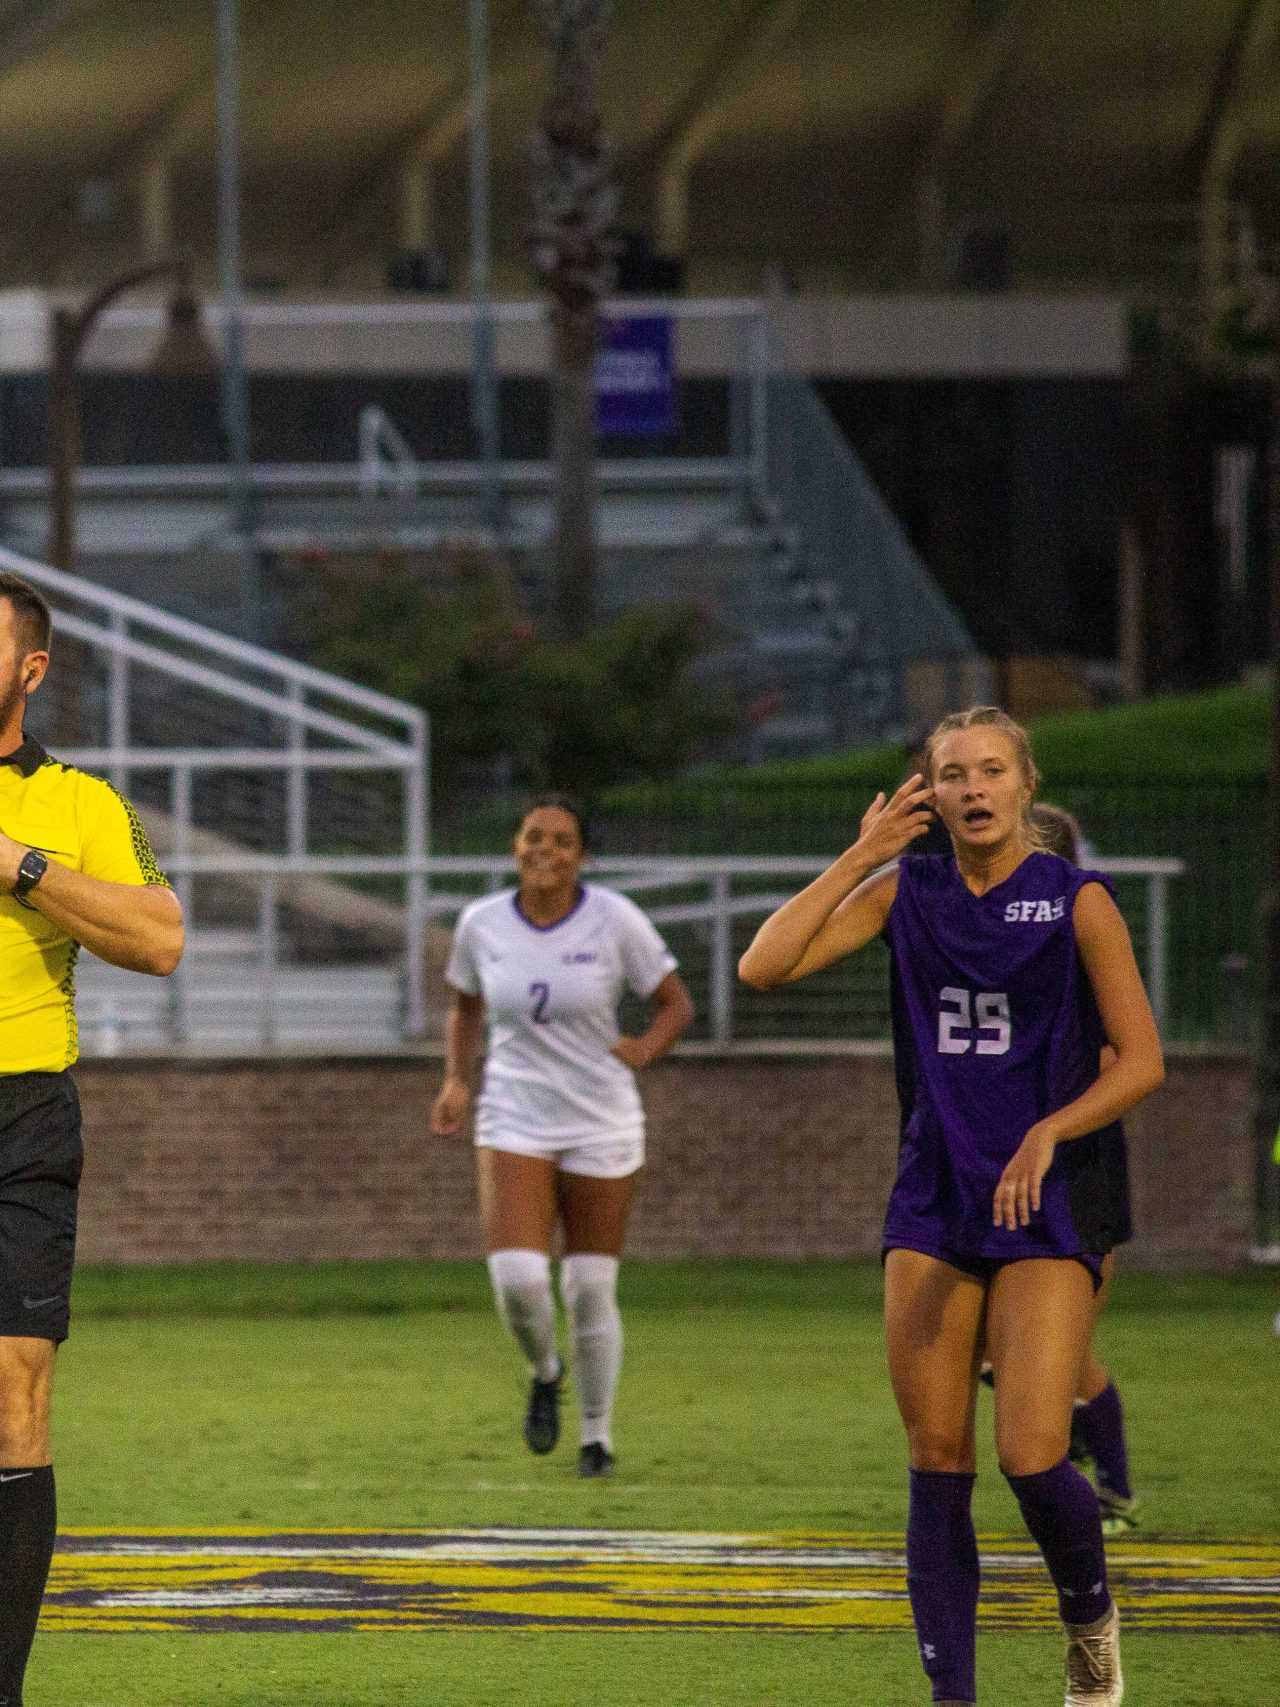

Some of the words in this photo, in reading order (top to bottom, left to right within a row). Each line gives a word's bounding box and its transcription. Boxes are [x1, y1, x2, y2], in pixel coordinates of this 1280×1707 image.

[1004, 899, 1056, 923] SFA
[529, 982, 550, 1025] 2
[937, 986, 1012, 1055] 29
